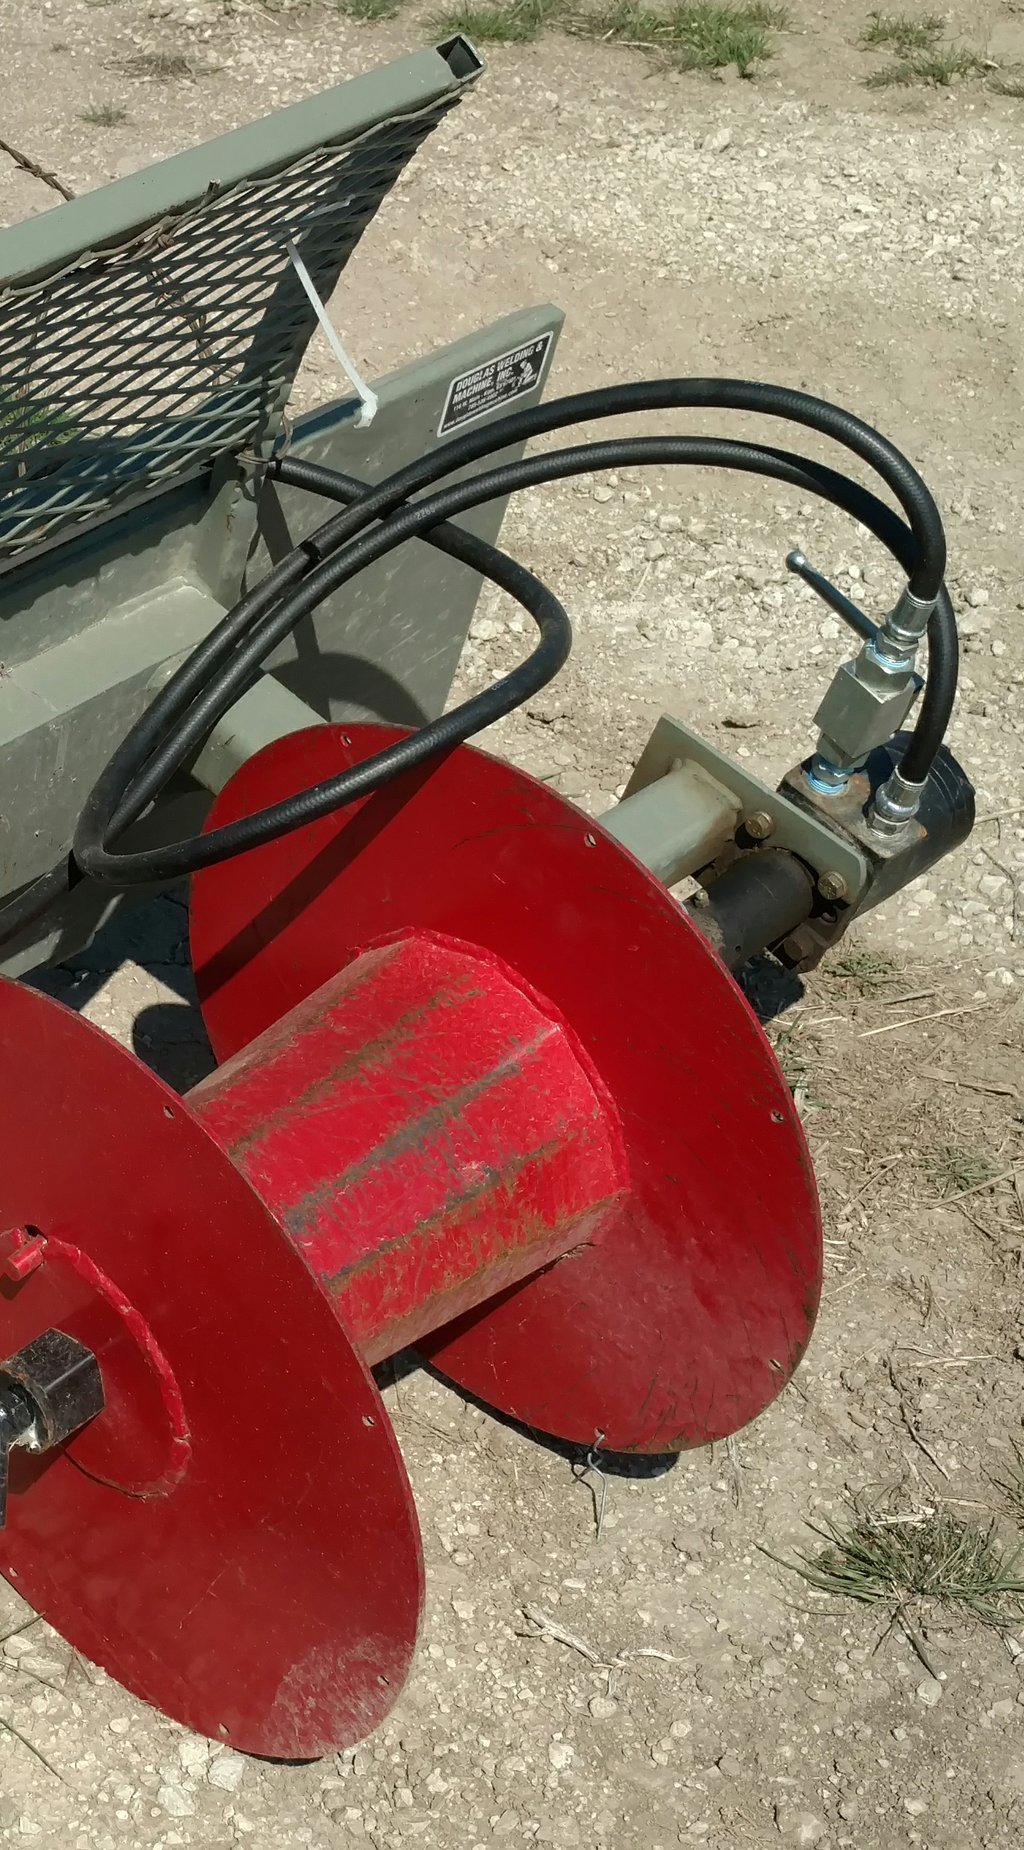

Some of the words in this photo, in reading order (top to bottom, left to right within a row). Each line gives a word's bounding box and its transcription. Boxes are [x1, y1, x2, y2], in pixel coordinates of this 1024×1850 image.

[452, 377, 494, 404] MACHINE,
[497, 367, 514, 382] INC.
[456, 365, 495, 392] DOUGLAS
[497, 345, 534, 372] WELDING
[536, 341, 543, 352] &
